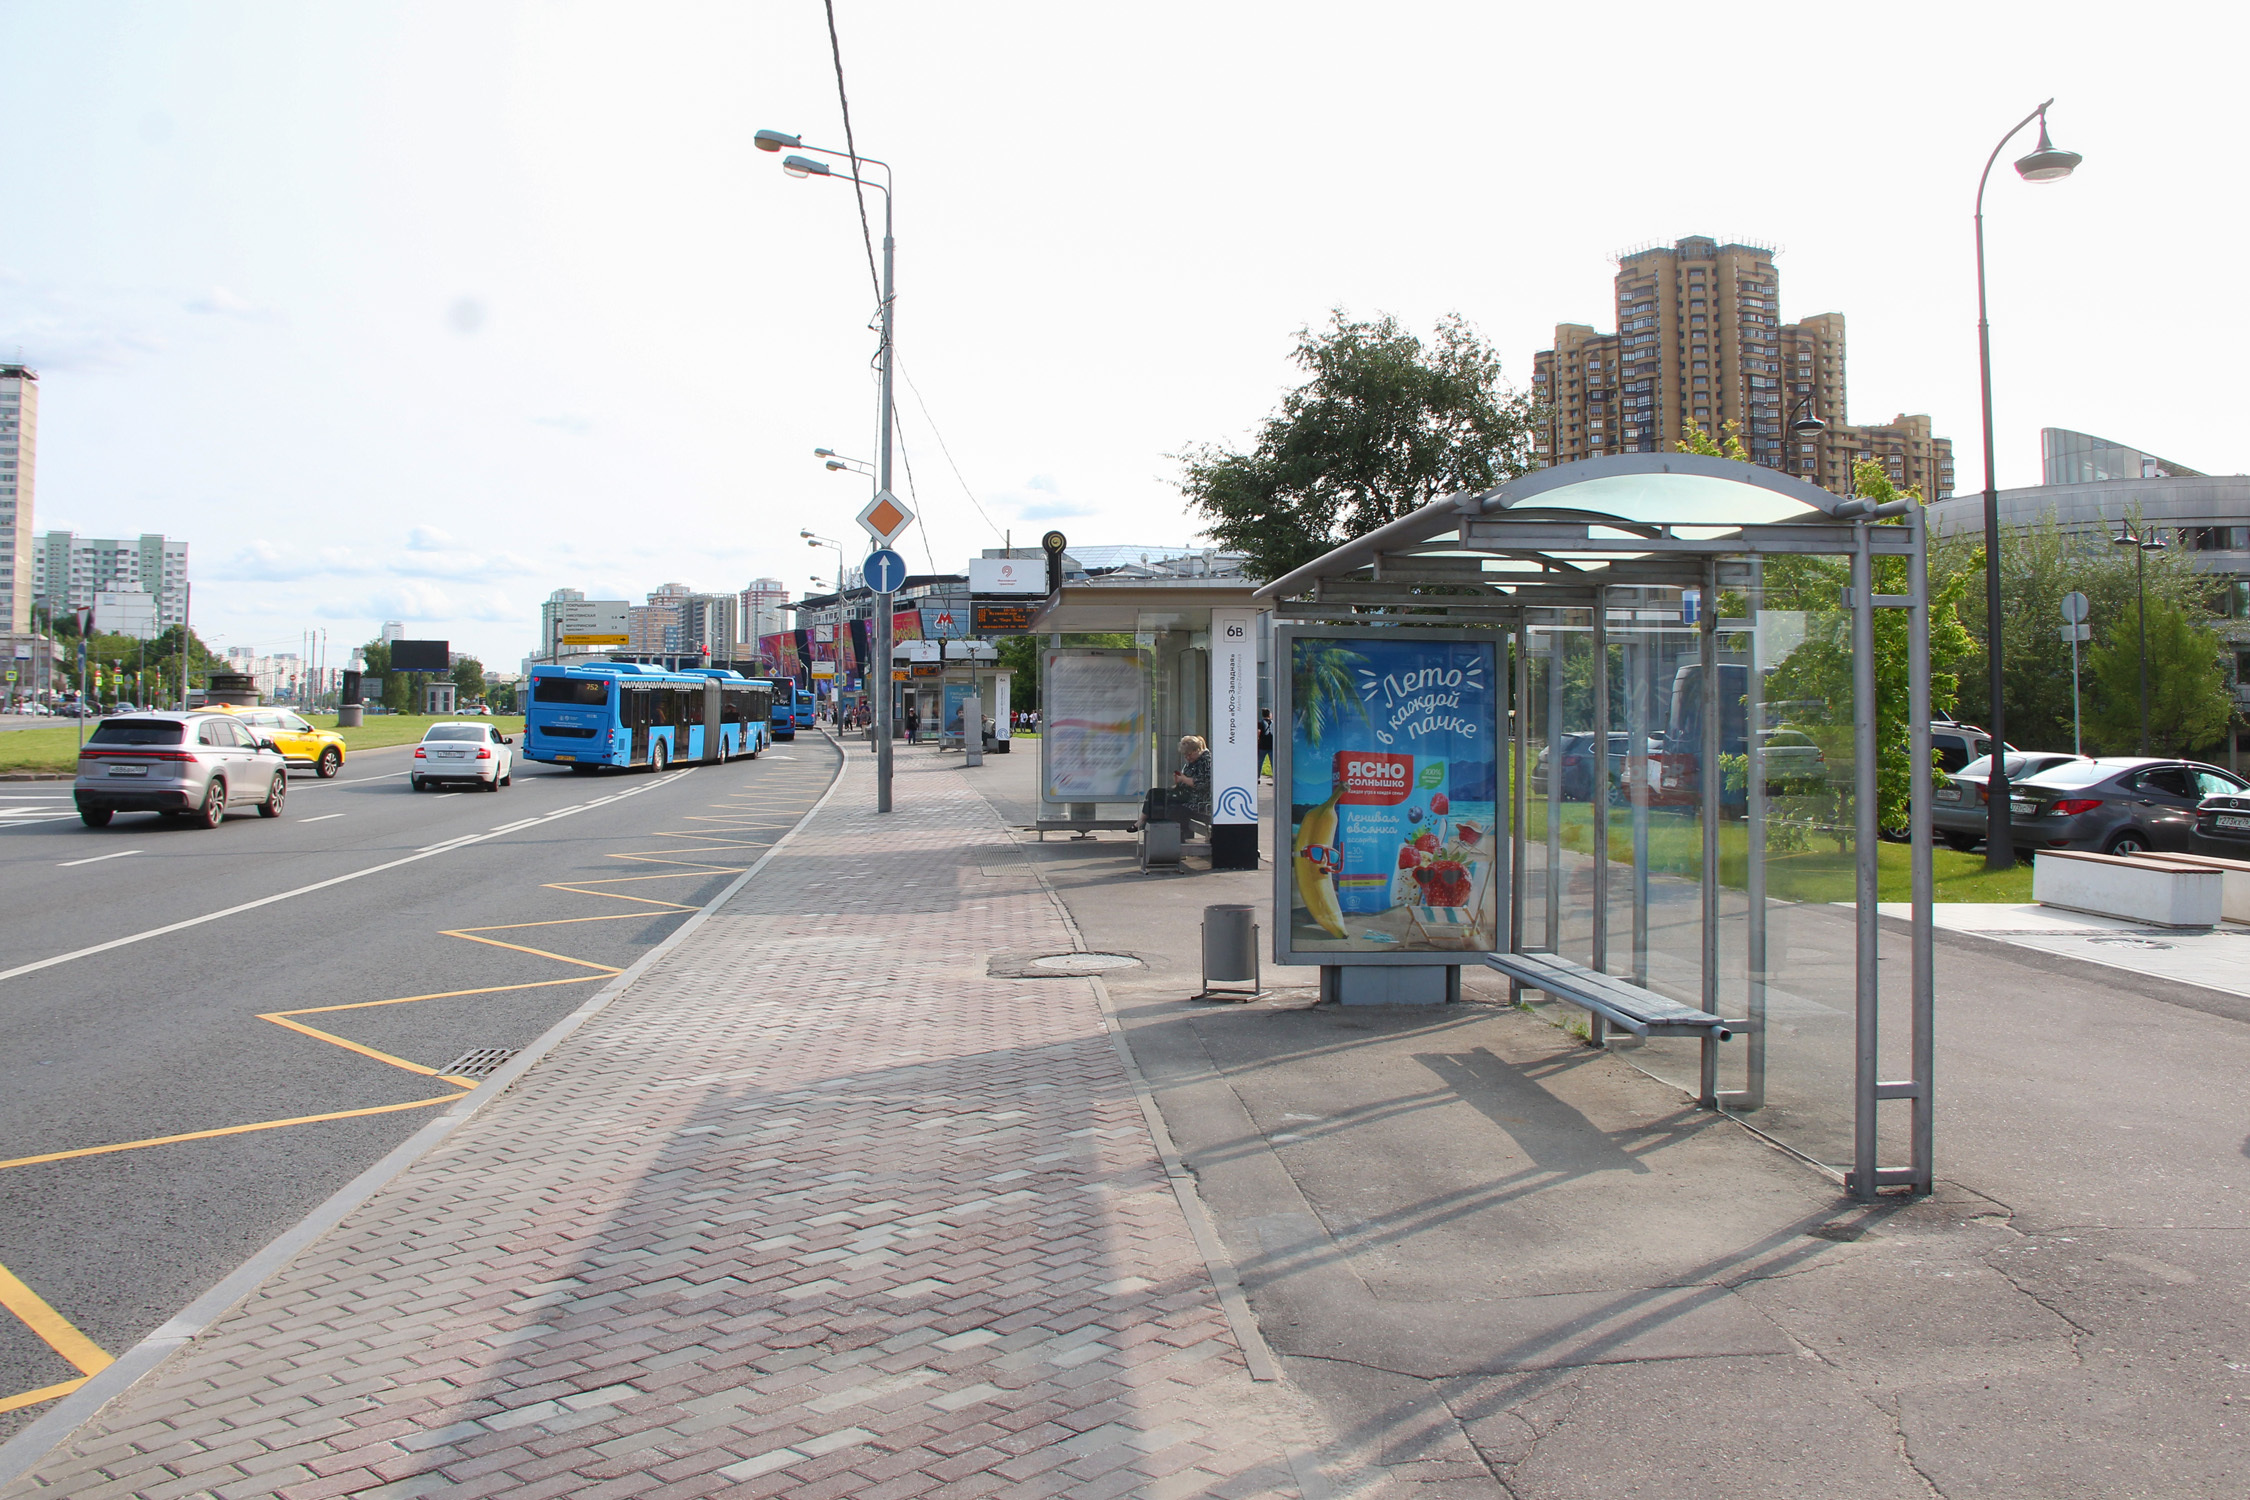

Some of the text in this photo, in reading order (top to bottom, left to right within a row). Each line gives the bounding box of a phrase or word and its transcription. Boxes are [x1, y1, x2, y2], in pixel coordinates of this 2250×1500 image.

[1384, 667, 1462, 709] Лето
[1376, 691, 1460, 744] в каждой
[1408, 716, 1476, 740] пачке
[1348, 761, 1405, 779] ЯСНО
[1348, 778, 1404, 788] СОЛНЫШКО
[1347, 811, 1400, 823] Ленивая
[1346, 823, 1398, 834] овсянка
